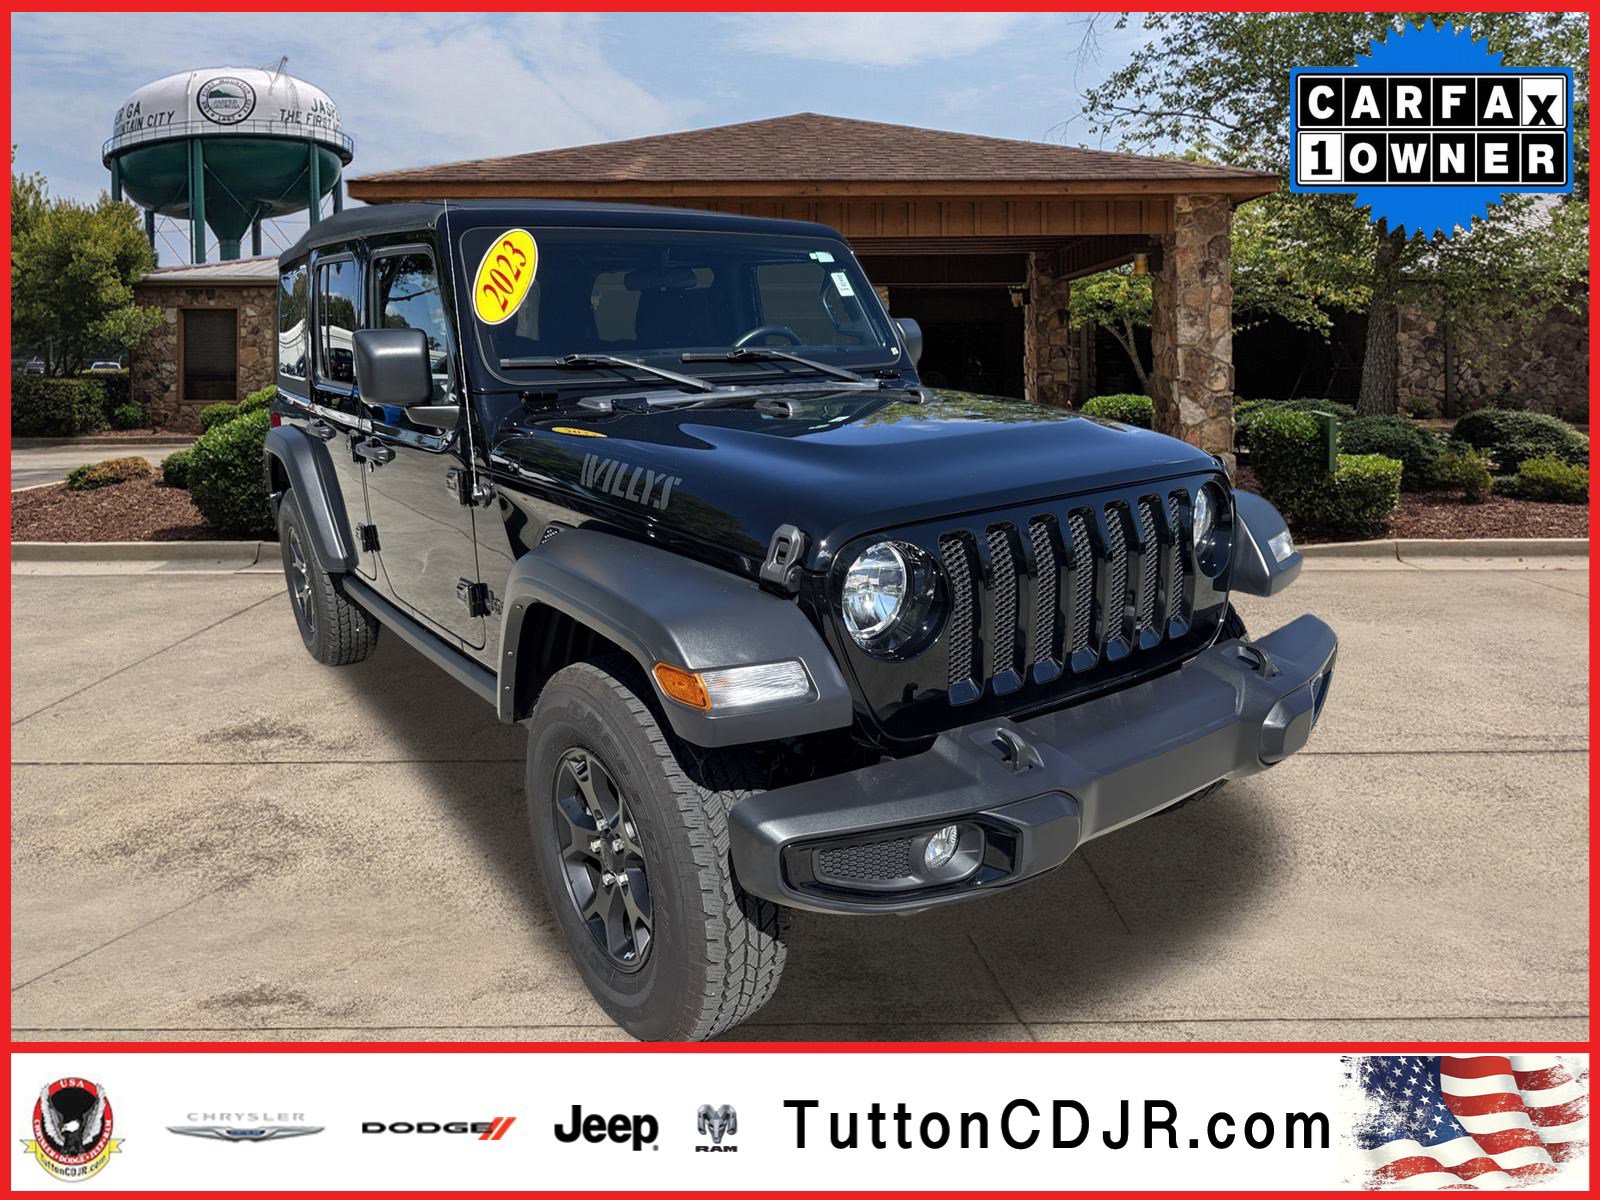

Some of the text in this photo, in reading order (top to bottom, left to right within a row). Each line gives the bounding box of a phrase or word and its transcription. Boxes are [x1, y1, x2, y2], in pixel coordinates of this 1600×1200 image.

[126, 101, 141, 119] GA
[147, 110, 176, 127] CITY
[280, 109, 302, 124] THE
[306, 112, 332, 129] FIRST
[483, 240, 527, 312] 2023
[580, 453, 682, 510] WILLYS
